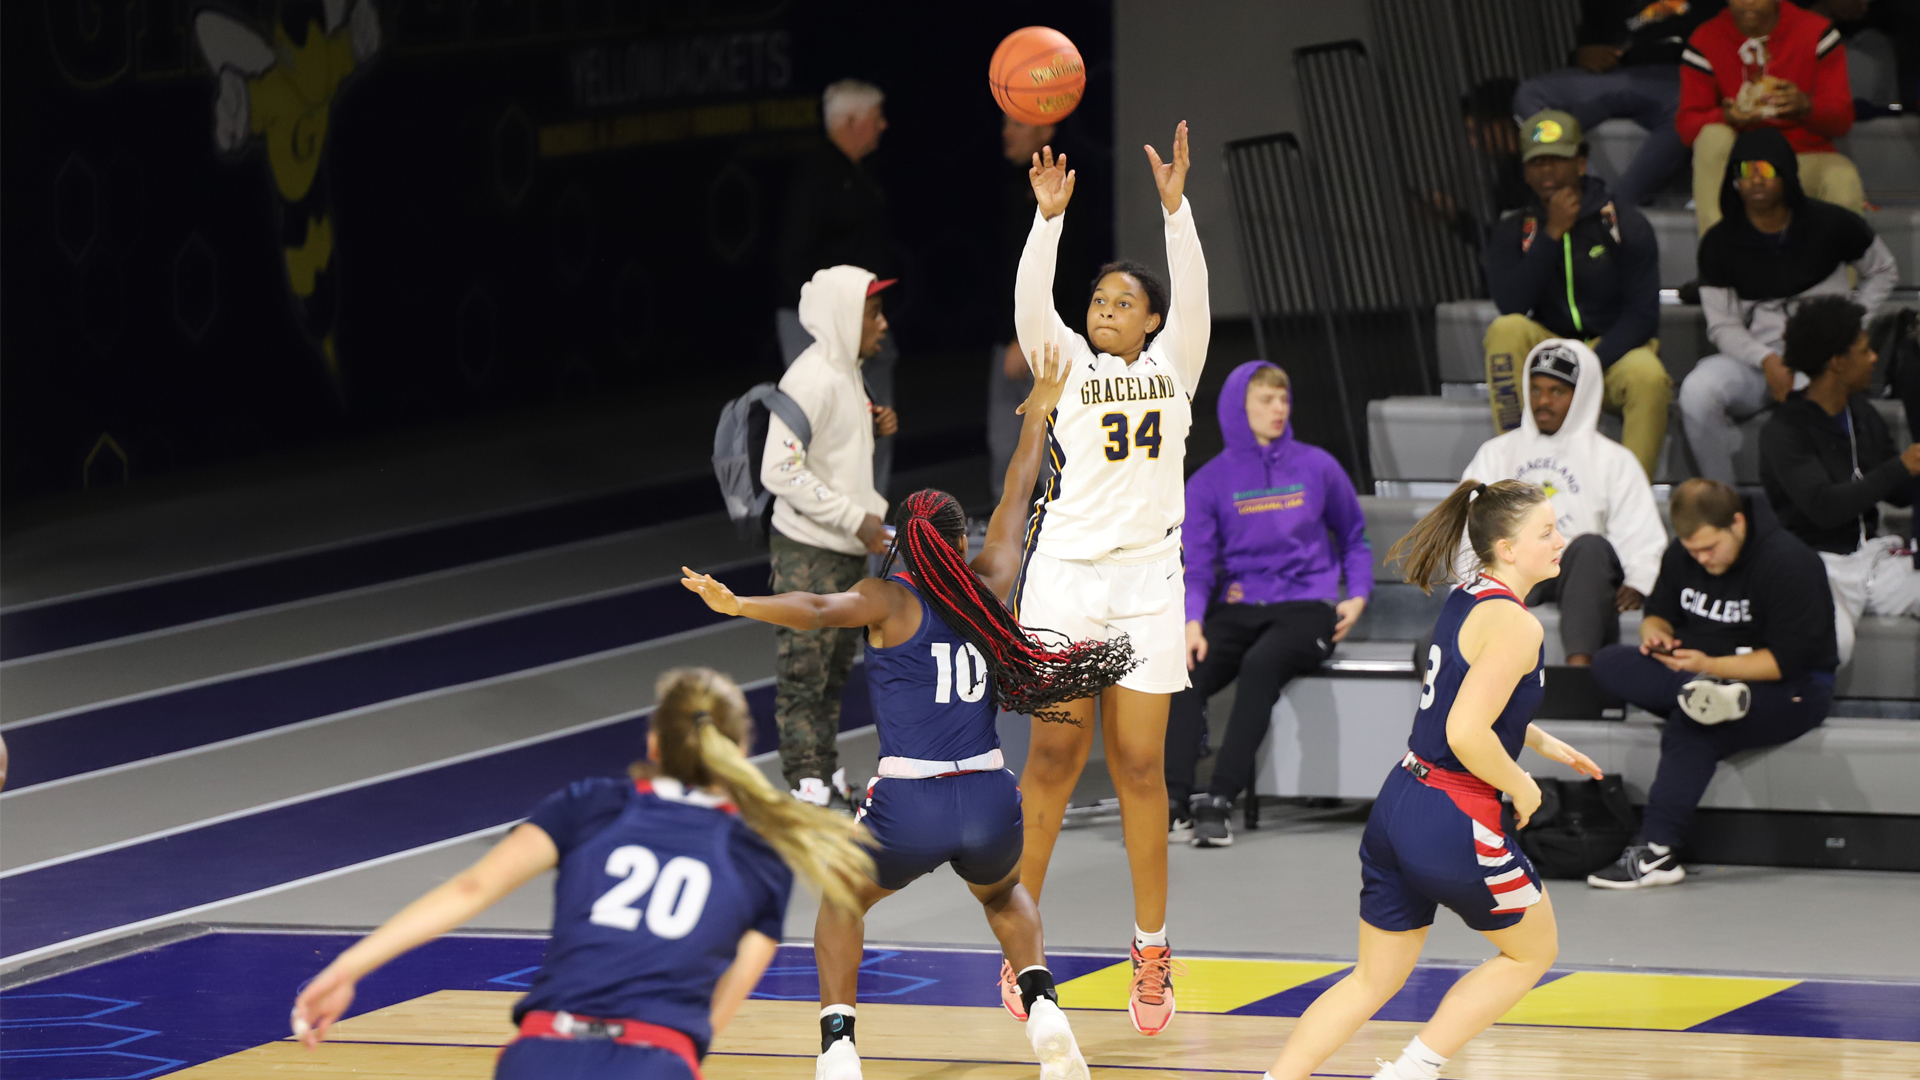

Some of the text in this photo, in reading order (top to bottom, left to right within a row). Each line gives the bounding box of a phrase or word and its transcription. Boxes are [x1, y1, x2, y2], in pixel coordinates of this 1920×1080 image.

[1081, 374, 1175, 405] GRACELAND
[1100, 409, 1163, 463] 34
[1515, 457, 1581, 495] RACELAND
[931, 642, 988, 704] 10
[589, 844, 712, 940] 20
